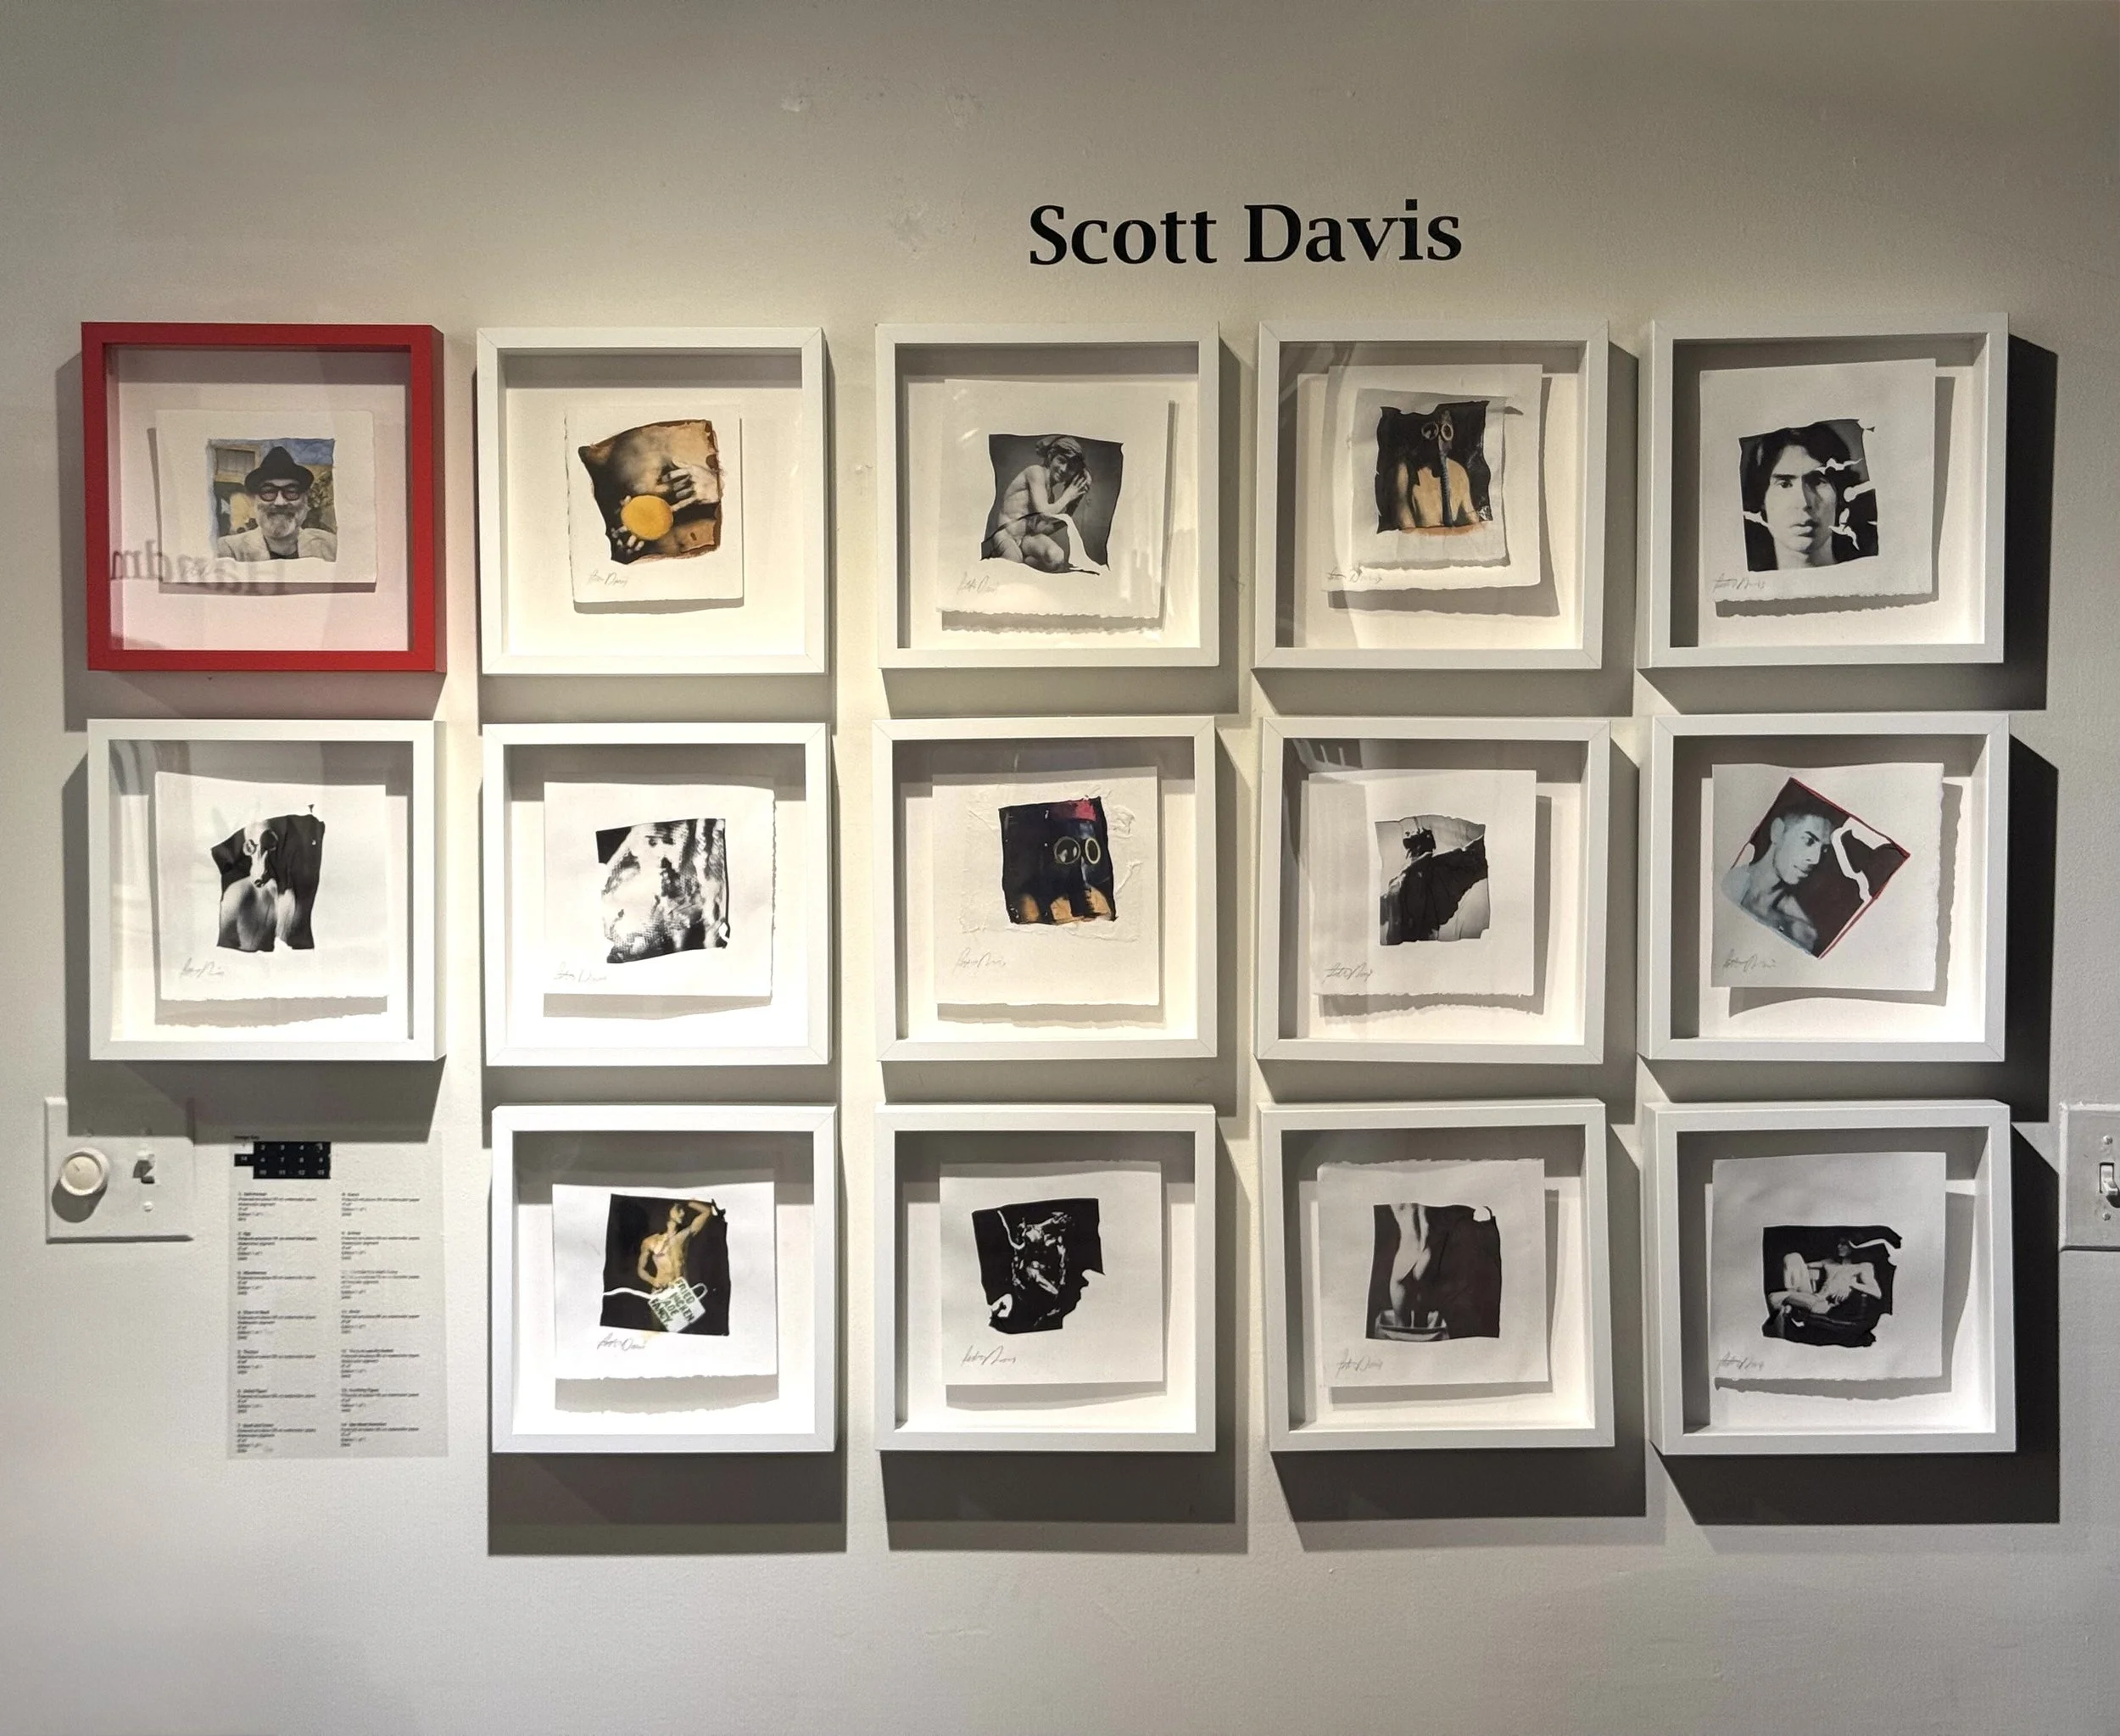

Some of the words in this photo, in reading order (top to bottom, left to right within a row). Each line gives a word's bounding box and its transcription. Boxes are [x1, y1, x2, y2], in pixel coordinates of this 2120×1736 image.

[1029, 204, 1217, 265] Scott
[1244, 198, 1462, 263] Davis
[675, 1278, 695, 1304] FRIED
